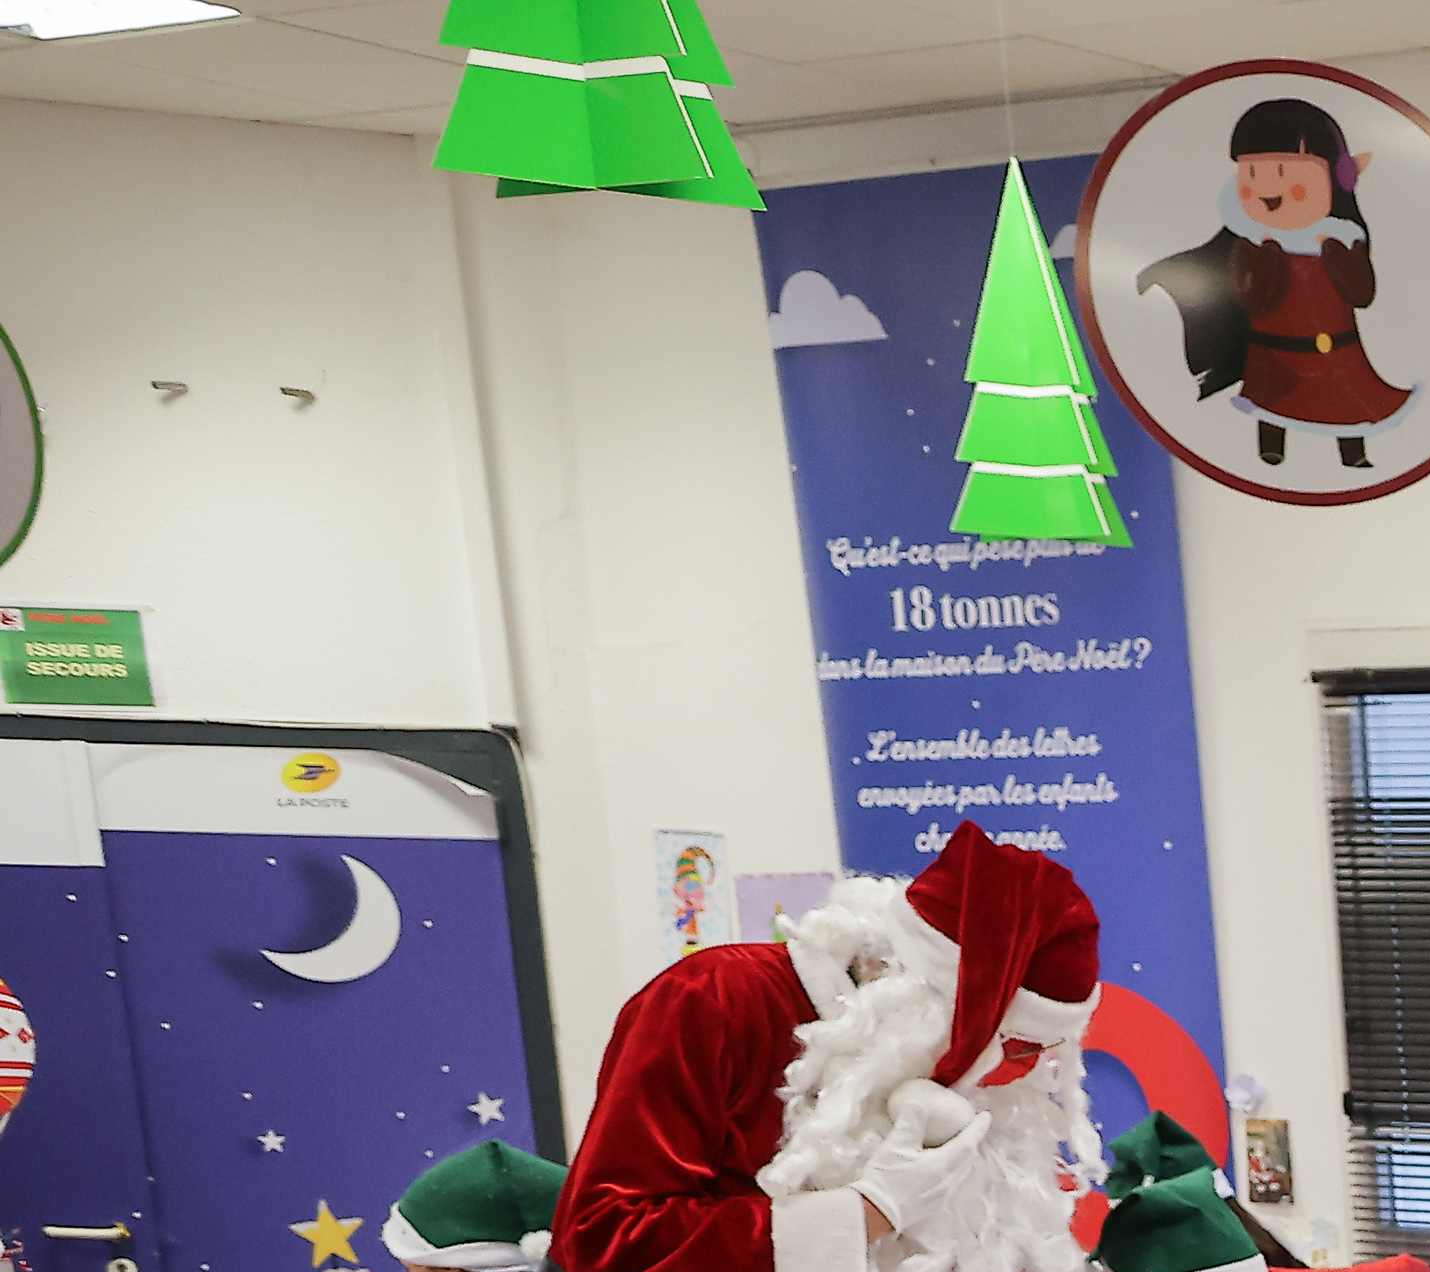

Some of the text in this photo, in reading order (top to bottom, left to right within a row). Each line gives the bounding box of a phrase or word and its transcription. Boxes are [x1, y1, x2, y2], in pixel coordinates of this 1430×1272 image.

[890, 586, 1061, 632] 18 tonnes
[26, 642, 124, 659] ISSUE DE
[26, 661, 129, 678] SECOURS
